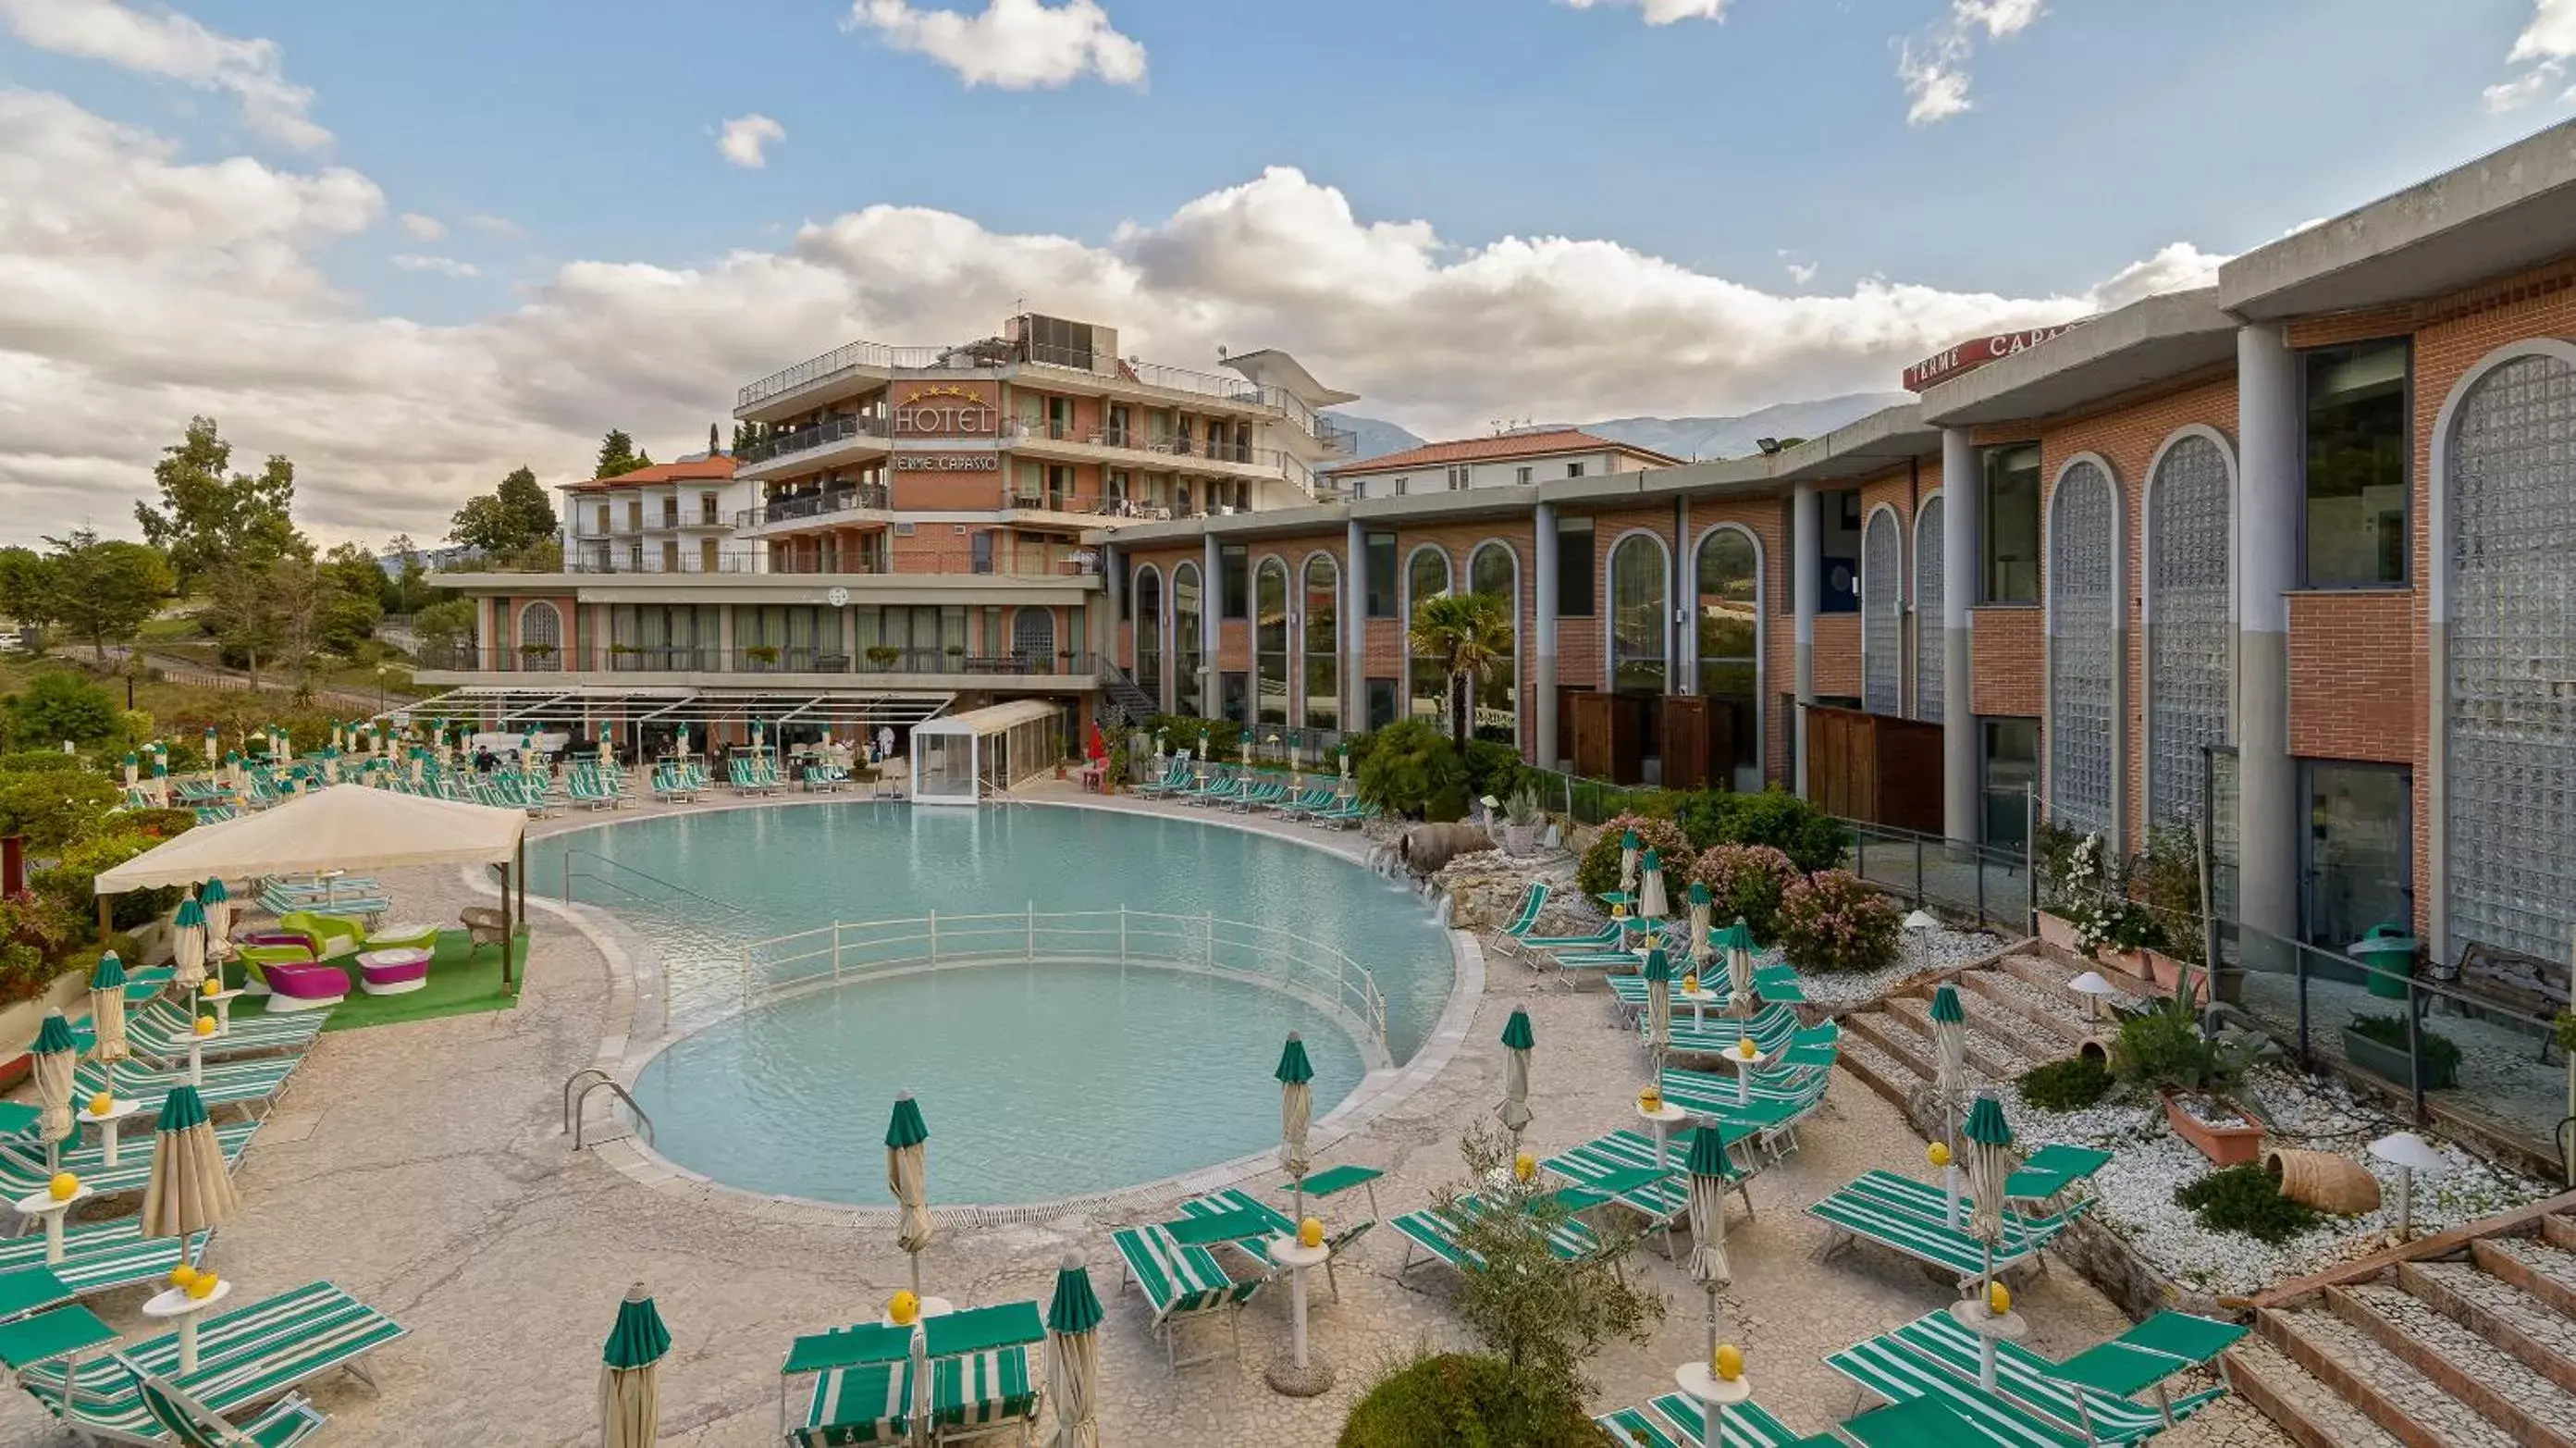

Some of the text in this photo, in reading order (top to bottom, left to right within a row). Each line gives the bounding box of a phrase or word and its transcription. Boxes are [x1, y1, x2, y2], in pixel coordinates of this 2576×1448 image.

[1910, 348, 1960, 383] TERME
[896, 407, 992, 432] HOTEL
[939, 456, 998, 470] CAPASSO
